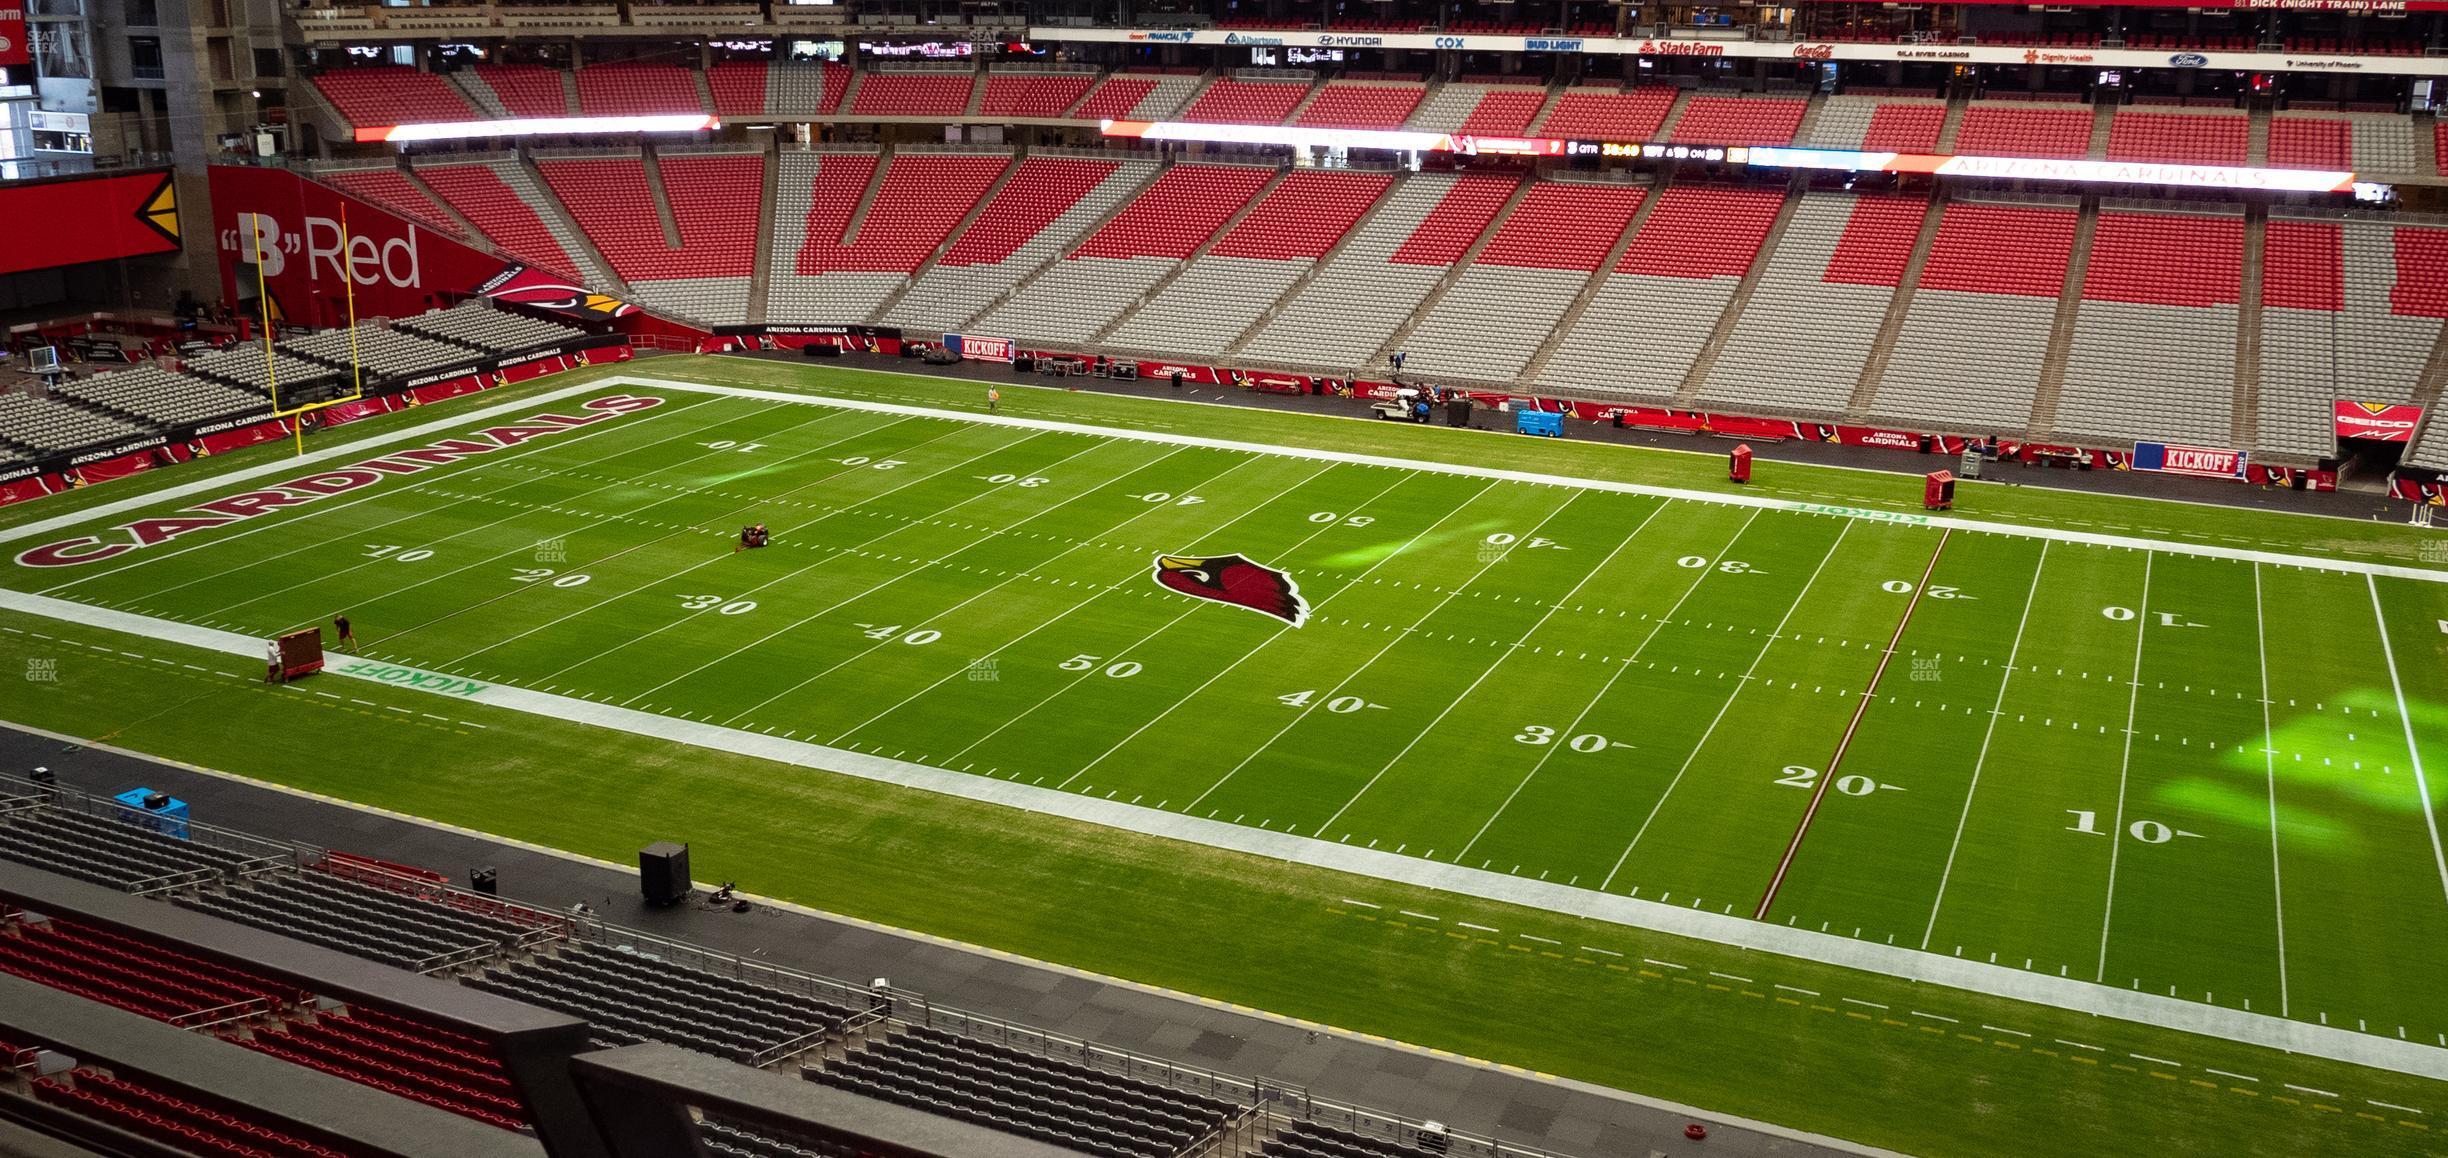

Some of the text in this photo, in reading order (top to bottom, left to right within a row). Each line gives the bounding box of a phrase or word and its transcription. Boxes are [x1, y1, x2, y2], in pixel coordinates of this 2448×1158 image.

[2250, 0, 2278, 8] DICK
[2281, 0, 2324, 9] (NIGHT
[2326, 1, 2369, 9] TRAIN)
[2372, 1, 2405, 10] LANE
[1337, 37, 1382, 46] HYUNDAI
[1435, 37, 1464, 49] COX
[1527, 41, 1581, 50] BUD LIGHT
[2042, 53, 2093, 62] Dignity Health
[2175, 55, 2201, 66] Ford
[2296, 60, 2326, 68] University
[1579, 144, 1598, 154] QTR
[305, 217, 421, 288] Red
[964, 340, 1006, 356] KICKOFF
[498, 348, 561, 367] ARIZONA CARDINALS
[408, 366, 477, 387] ARIZONA CARDINALS
[1153, 369, 1196, 379] CARALS
[195, 411, 274, 435] ARIZONA CARDINAL
[2337, 415, 2414, 429] GEICO
[1862, 436, 1918, 448] CARDINALS
[1874, 432, 1907, 440] ARIZONA
[71, 436, 168, 465] ARIZONA CARDINALS
[708, 440, 768, 453] 10
[841, 457, 907, 470] 20
[2166, 449, 2233, 472] KICKOFF
[13, 394, 666, 568] CARDINALS
[987, 474, 1050, 488] 30
[1142, 492, 1205, 506] 40
[1308, 512, 1375, 528] 50
[1486, 533, 1556, 549] 40
[362, 545, 434, 562] 10
[1677, 556, 1750, 574] 30
[511, 568, 591, 588] 20
[1882, 580, 1960, 599] 20
[681, 595, 757, 615] 30
[2102, 606, 2188, 627] 10
[864, 625, 942, 645] 40
[1058, 654, 1142, 678] 50
[337, 662, 489, 697] KICKOFF
[1277, 690, 1364, 714] 40
[1514, 725, 1607, 753] 30
[1774, 765, 1875, 796] 20
[2065, 809, 2172, 843] 10
